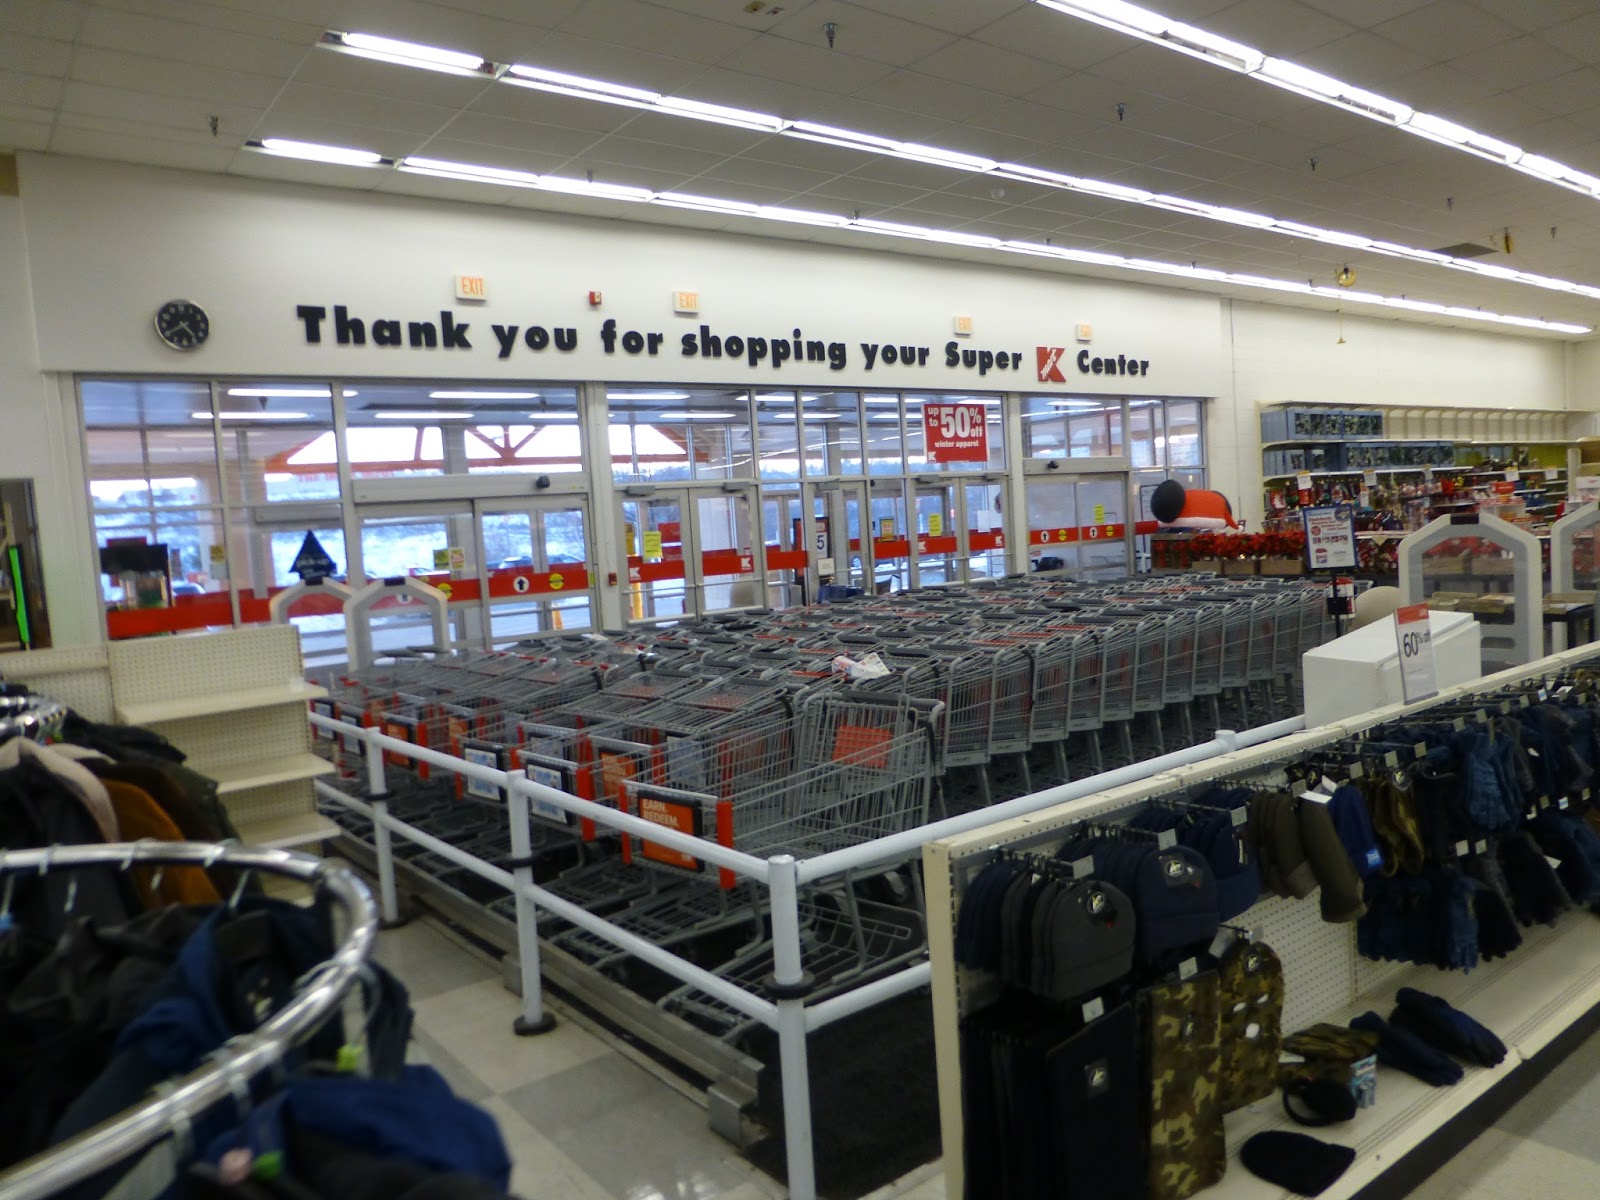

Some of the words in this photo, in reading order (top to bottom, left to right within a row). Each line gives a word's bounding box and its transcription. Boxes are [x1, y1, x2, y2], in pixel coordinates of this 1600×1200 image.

[462, 276, 484, 296] EXIT
[679, 292, 698, 309] EXIT
[296, 304, 473, 349] Thank
[491, 324, 578, 359] you
[600, 318, 664, 355] for
[681, 325, 847, 370] shopping
[860, 343, 930, 370] your
[945, 341, 1022, 375] Super
[1036, 346, 1067, 382] K
[1076, 349, 1149, 376] Center
[927, 407, 939, 416] up
[940, 406, 982, 438] 50%
[928, 417, 939, 427] to
[970, 426, 983, 438] off
[956, 440, 979, 448] apparel
[642, 798, 668, 813] EARN.
[643, 810, 680, 828] REDEEM.
